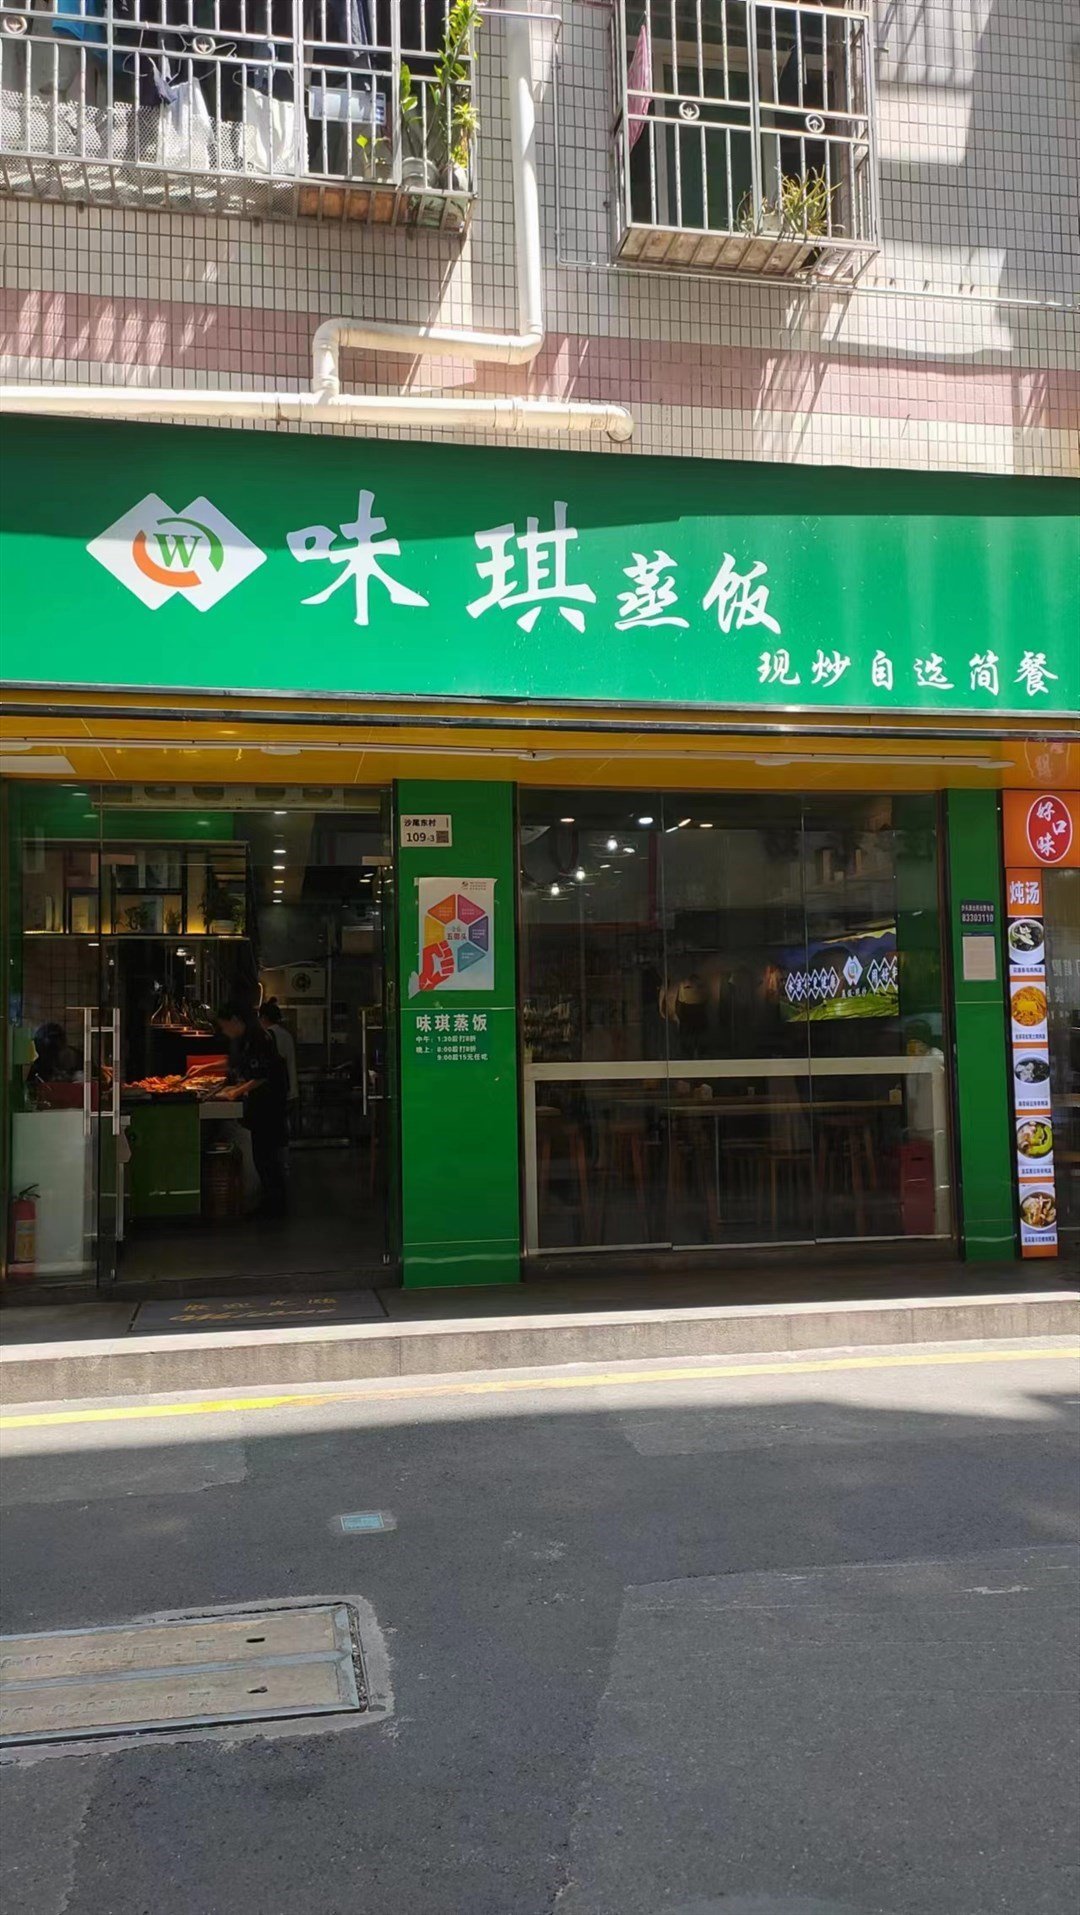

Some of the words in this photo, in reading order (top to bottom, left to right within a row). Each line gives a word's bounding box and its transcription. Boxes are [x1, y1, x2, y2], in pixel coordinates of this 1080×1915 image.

[154, 532, 202, 568] W
[286, 489, 781, 634] 味琪蒸饭
[757, 649, 1059, 697] 现炒自选简餐
[404, 818, 436, 827] 沙尾东村
[1036, 801, 1067, 857] 好口味
[1009, 881, 1040, 905] 炖汤
[416, 1014, 487, 1032] 味琪蒸饭
